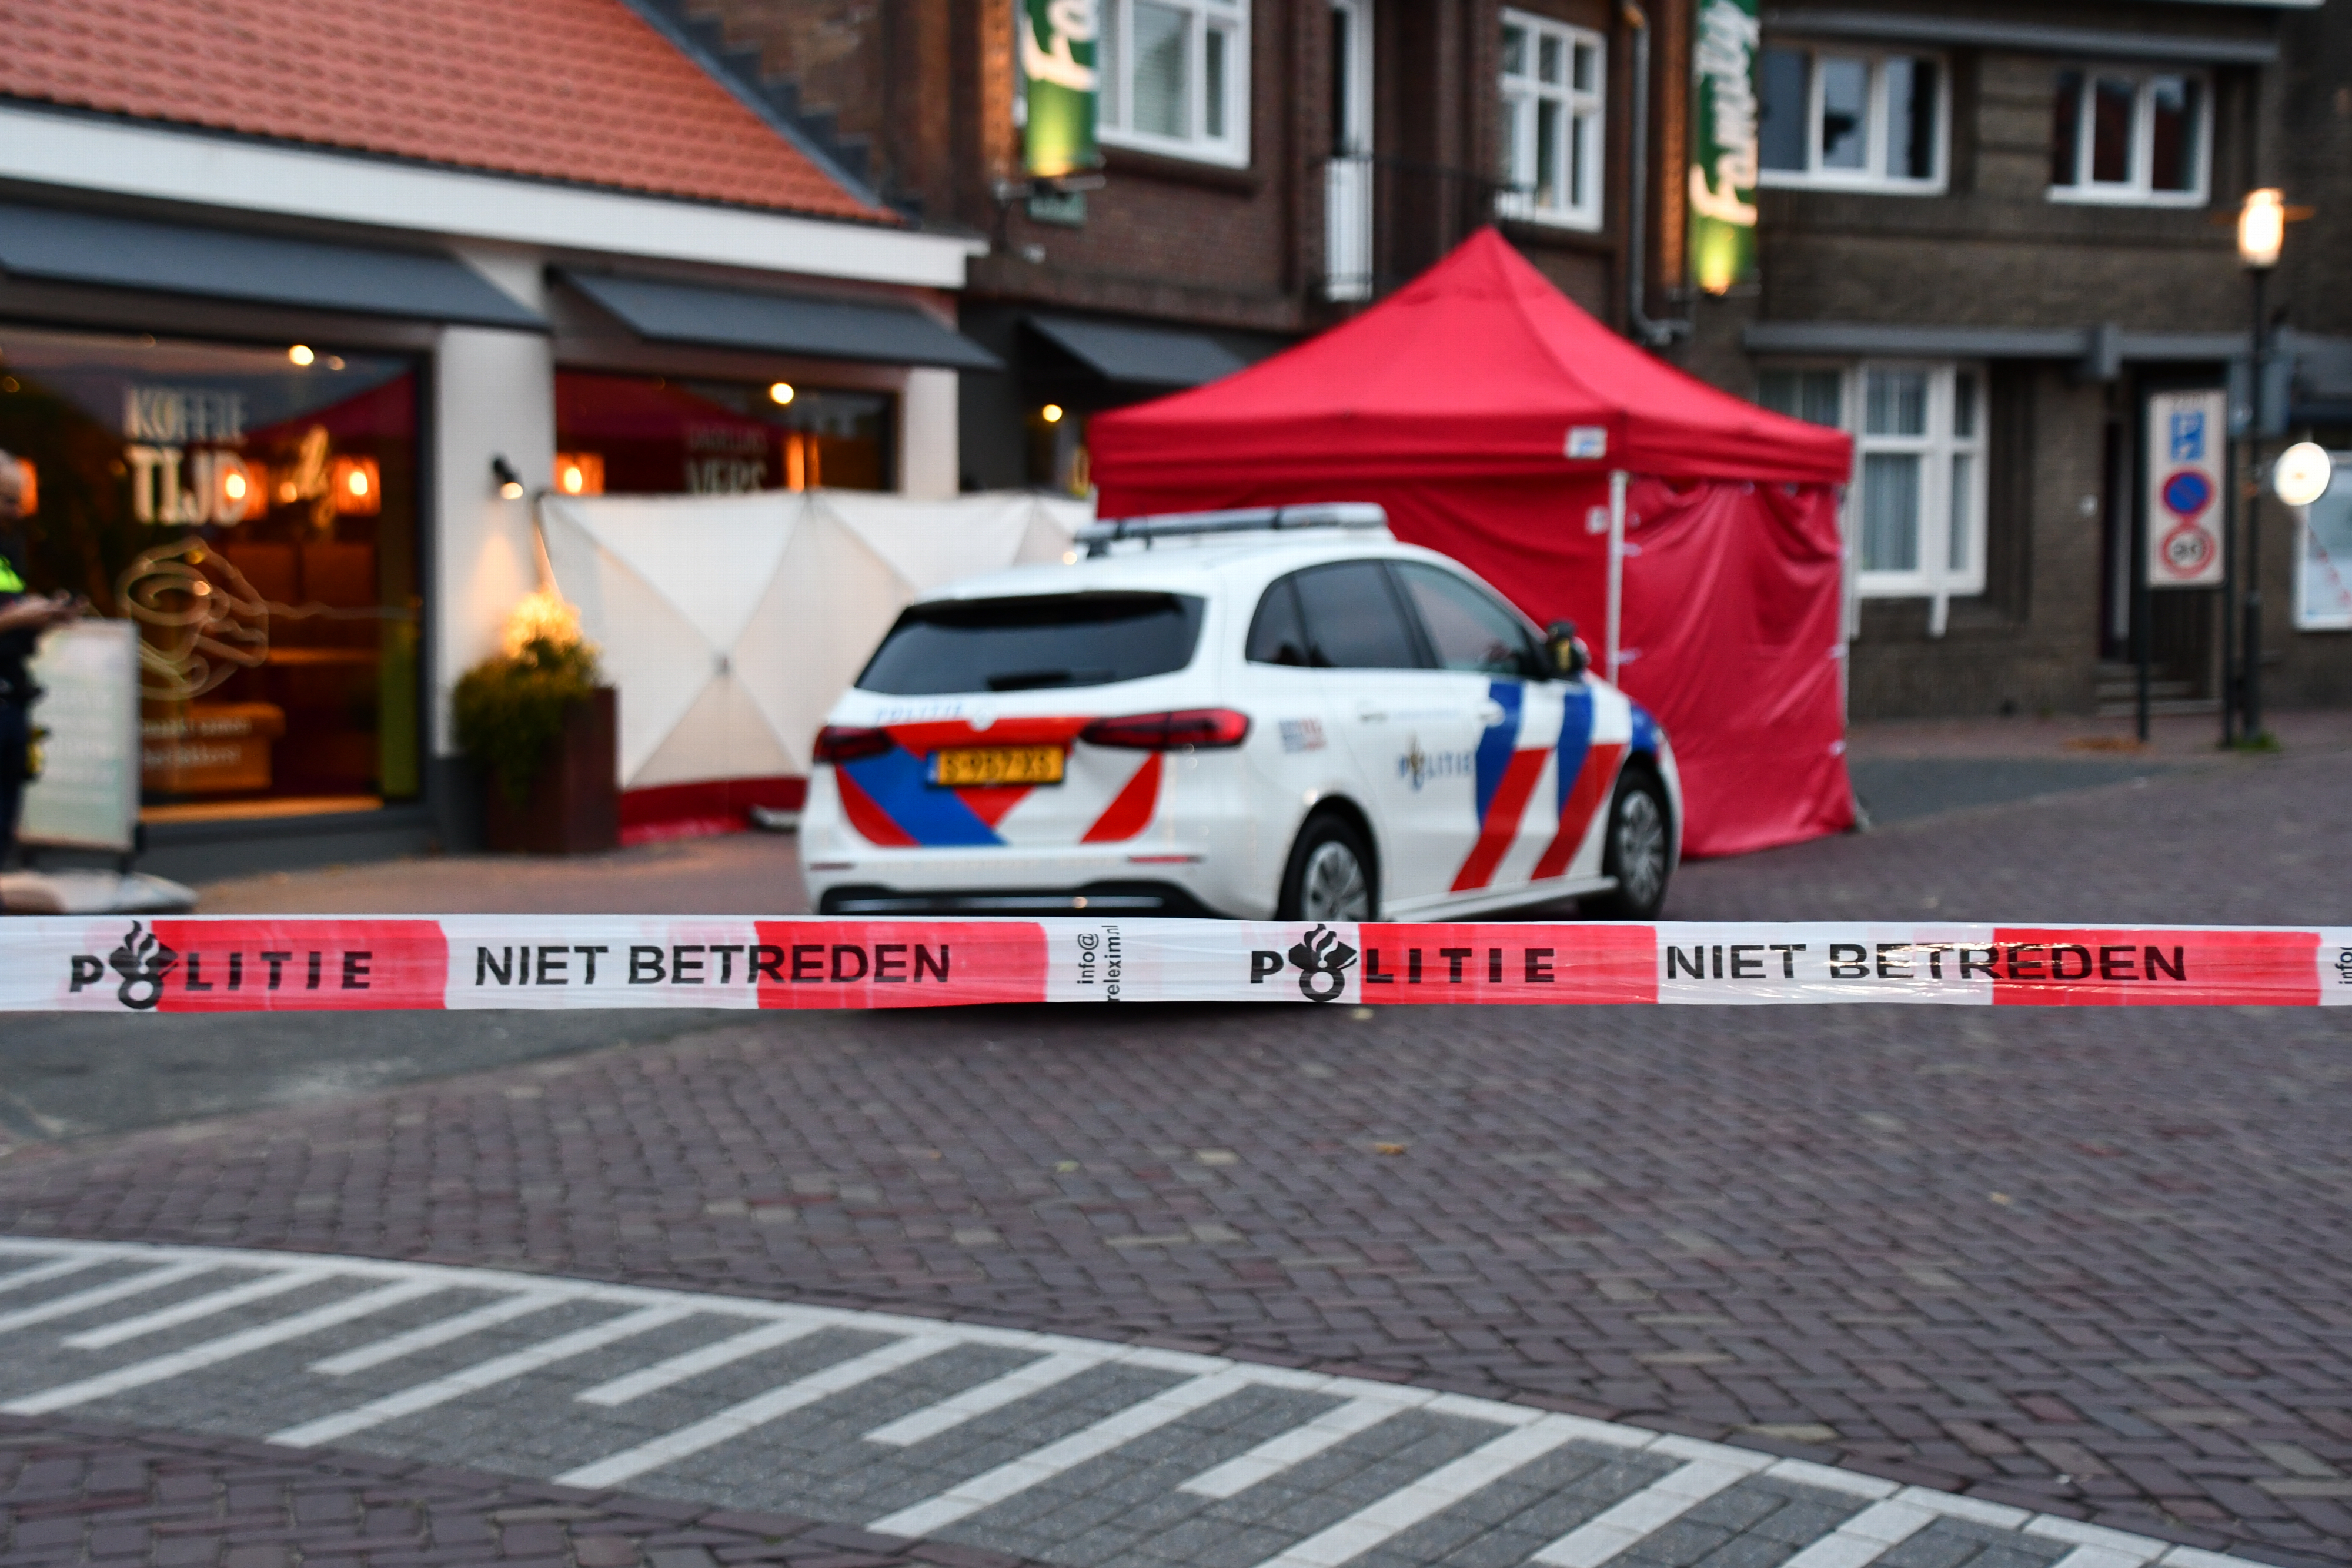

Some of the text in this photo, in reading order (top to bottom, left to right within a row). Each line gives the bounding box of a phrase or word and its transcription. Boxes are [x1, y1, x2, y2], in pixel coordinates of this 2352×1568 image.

[124, 386, 247, 443] KOFFIE
[126, 447, 248, 526] TIJD
[69, 944, 2187, 1009] POLITIE NIET BETREDEN POLITIE NIET BETREDEN
[1077, 933, 1099, 984] info@
[2334, 947, 2352, 984] info
